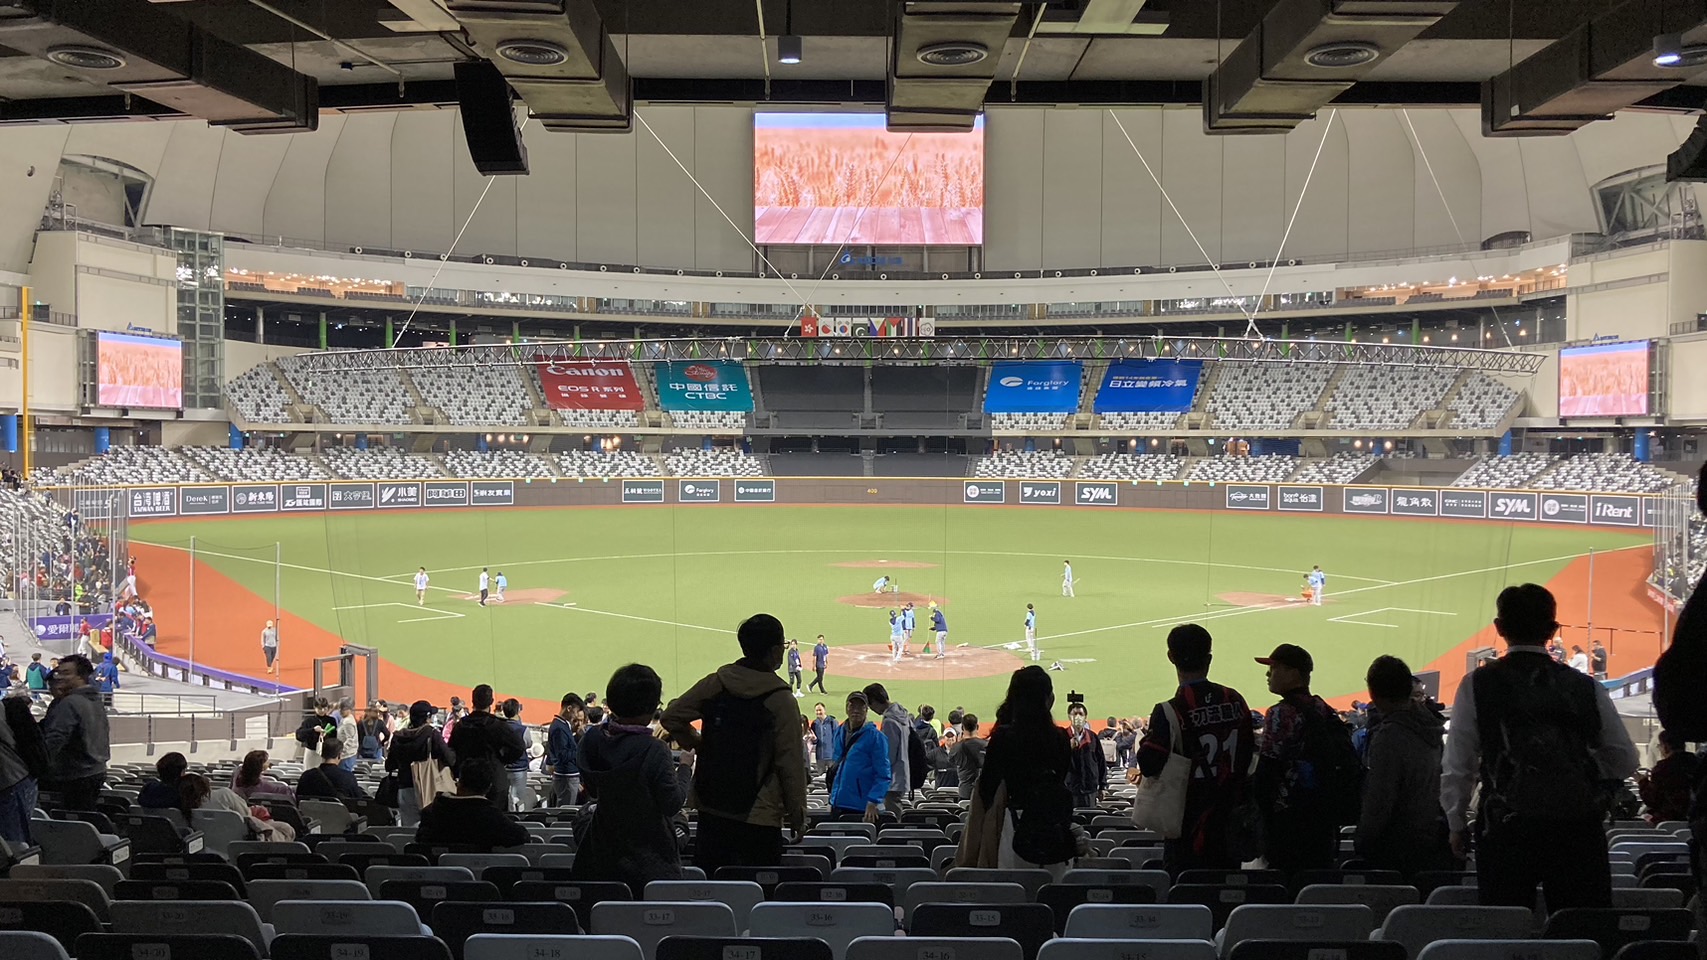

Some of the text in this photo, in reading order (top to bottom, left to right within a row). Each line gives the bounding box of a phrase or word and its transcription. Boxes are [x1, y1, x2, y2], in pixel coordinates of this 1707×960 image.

[546, 366, 624, 376] Canon
[668, 382, 738, 392] 中國信託
[1027, 379, 1070, 387] Farglory
[248, 491, 274, 502] 新東陽
[397, 486, 418, 497] 小美
[1033, 488, 1057, 498] yoxi
[1080, 487, 1112, 502] SYM
[133, 491, 170, 507] 台灣啤酒
[1494, 498, 1531, 515] SYM
[1595, 502, 1633, 518] iRent
[1194, 728, 1238, 778] 21
[648, 912, 671, 921] 33-17
[811, 913, 833, 921] 33-16
[975, 914, 996, 922] 33-15
[533, 948, 561, 958] 34-18
[728, 950, 756, 960] 34-17
[922, 950, 950, 960] 34-16
